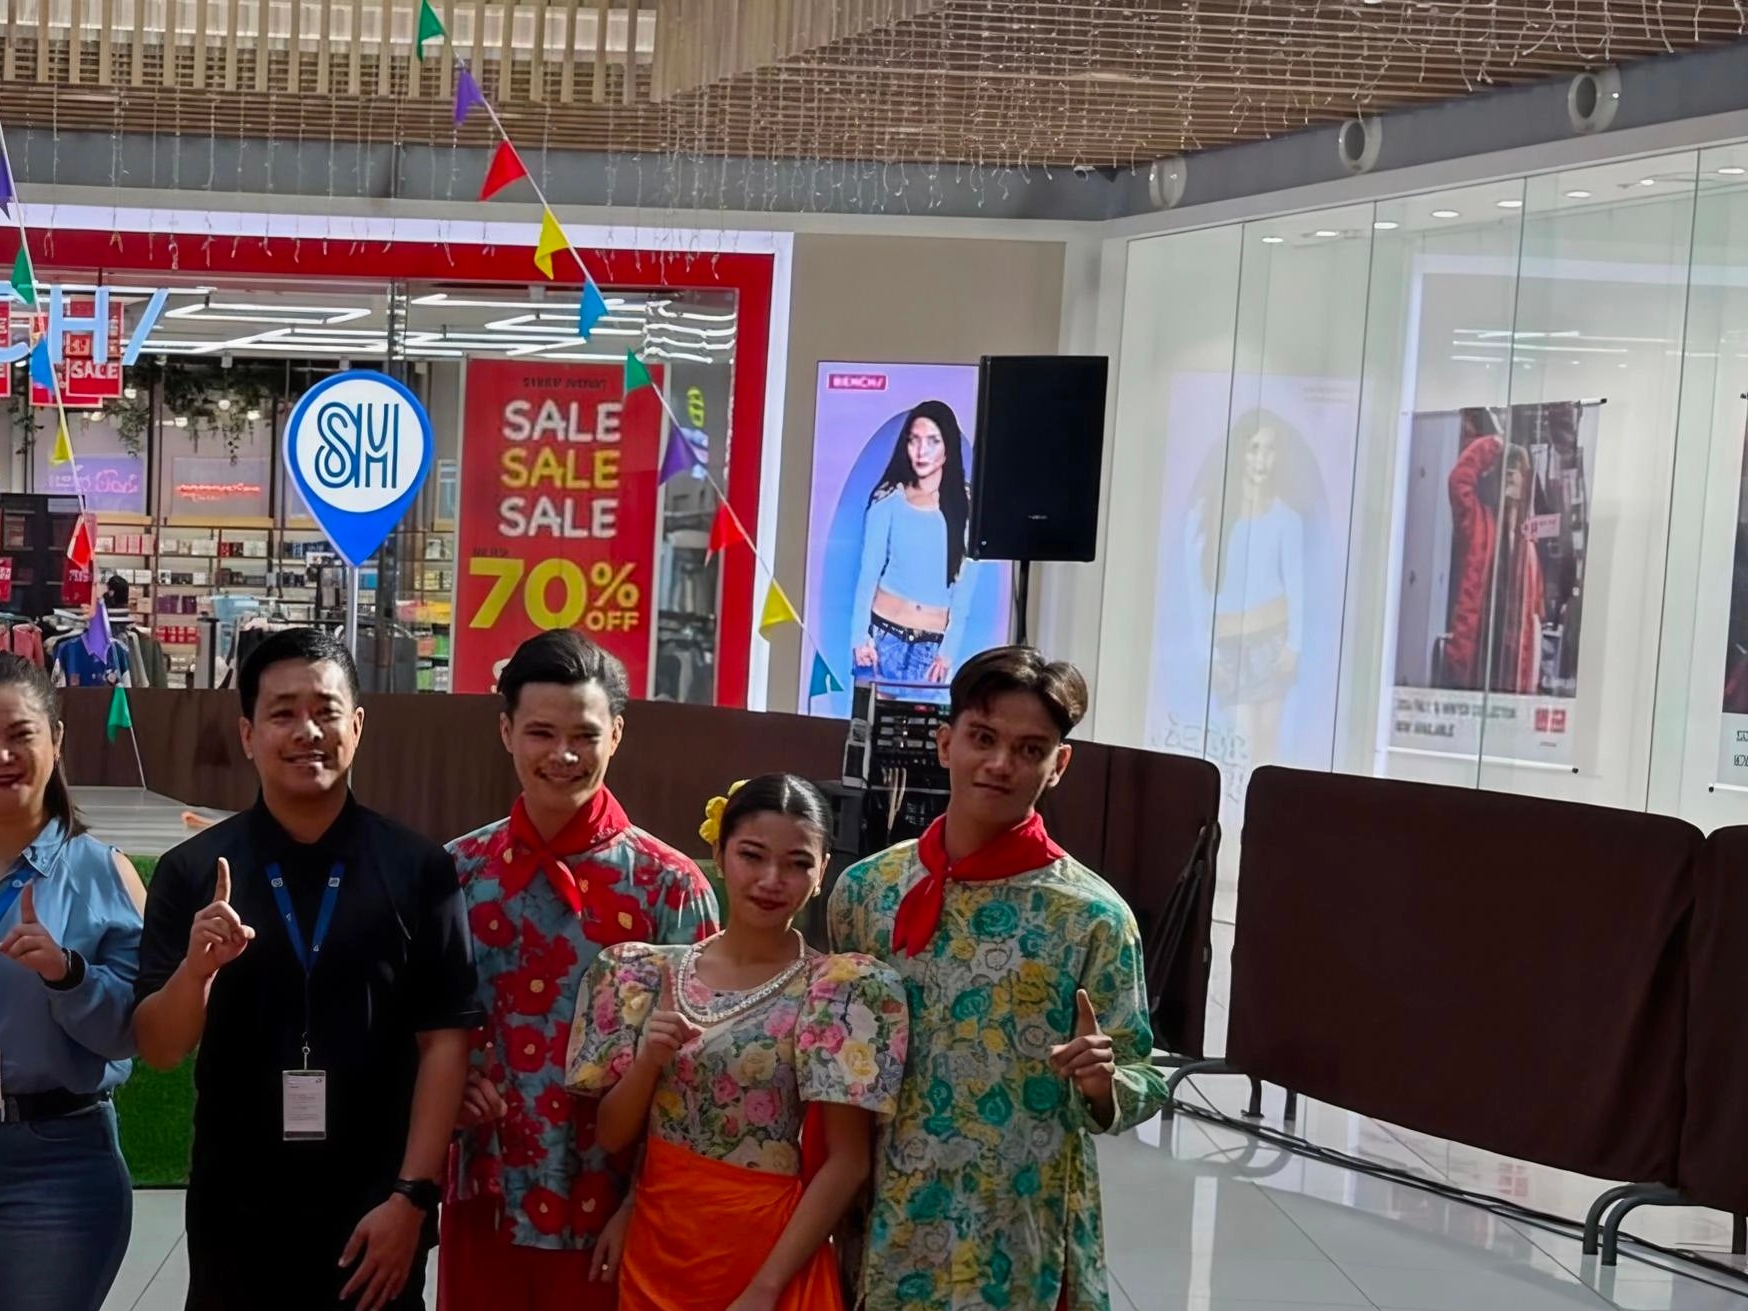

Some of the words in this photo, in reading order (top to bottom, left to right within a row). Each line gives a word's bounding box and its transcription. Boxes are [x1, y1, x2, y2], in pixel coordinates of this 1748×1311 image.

[502, 398, 623, 443] SALE
[501, 446, 620, 489] SALE
[498, 496, 619, 538] SALE
[469, 557, 639, 631] 70%
[586, 611, 640, 631] OFF
